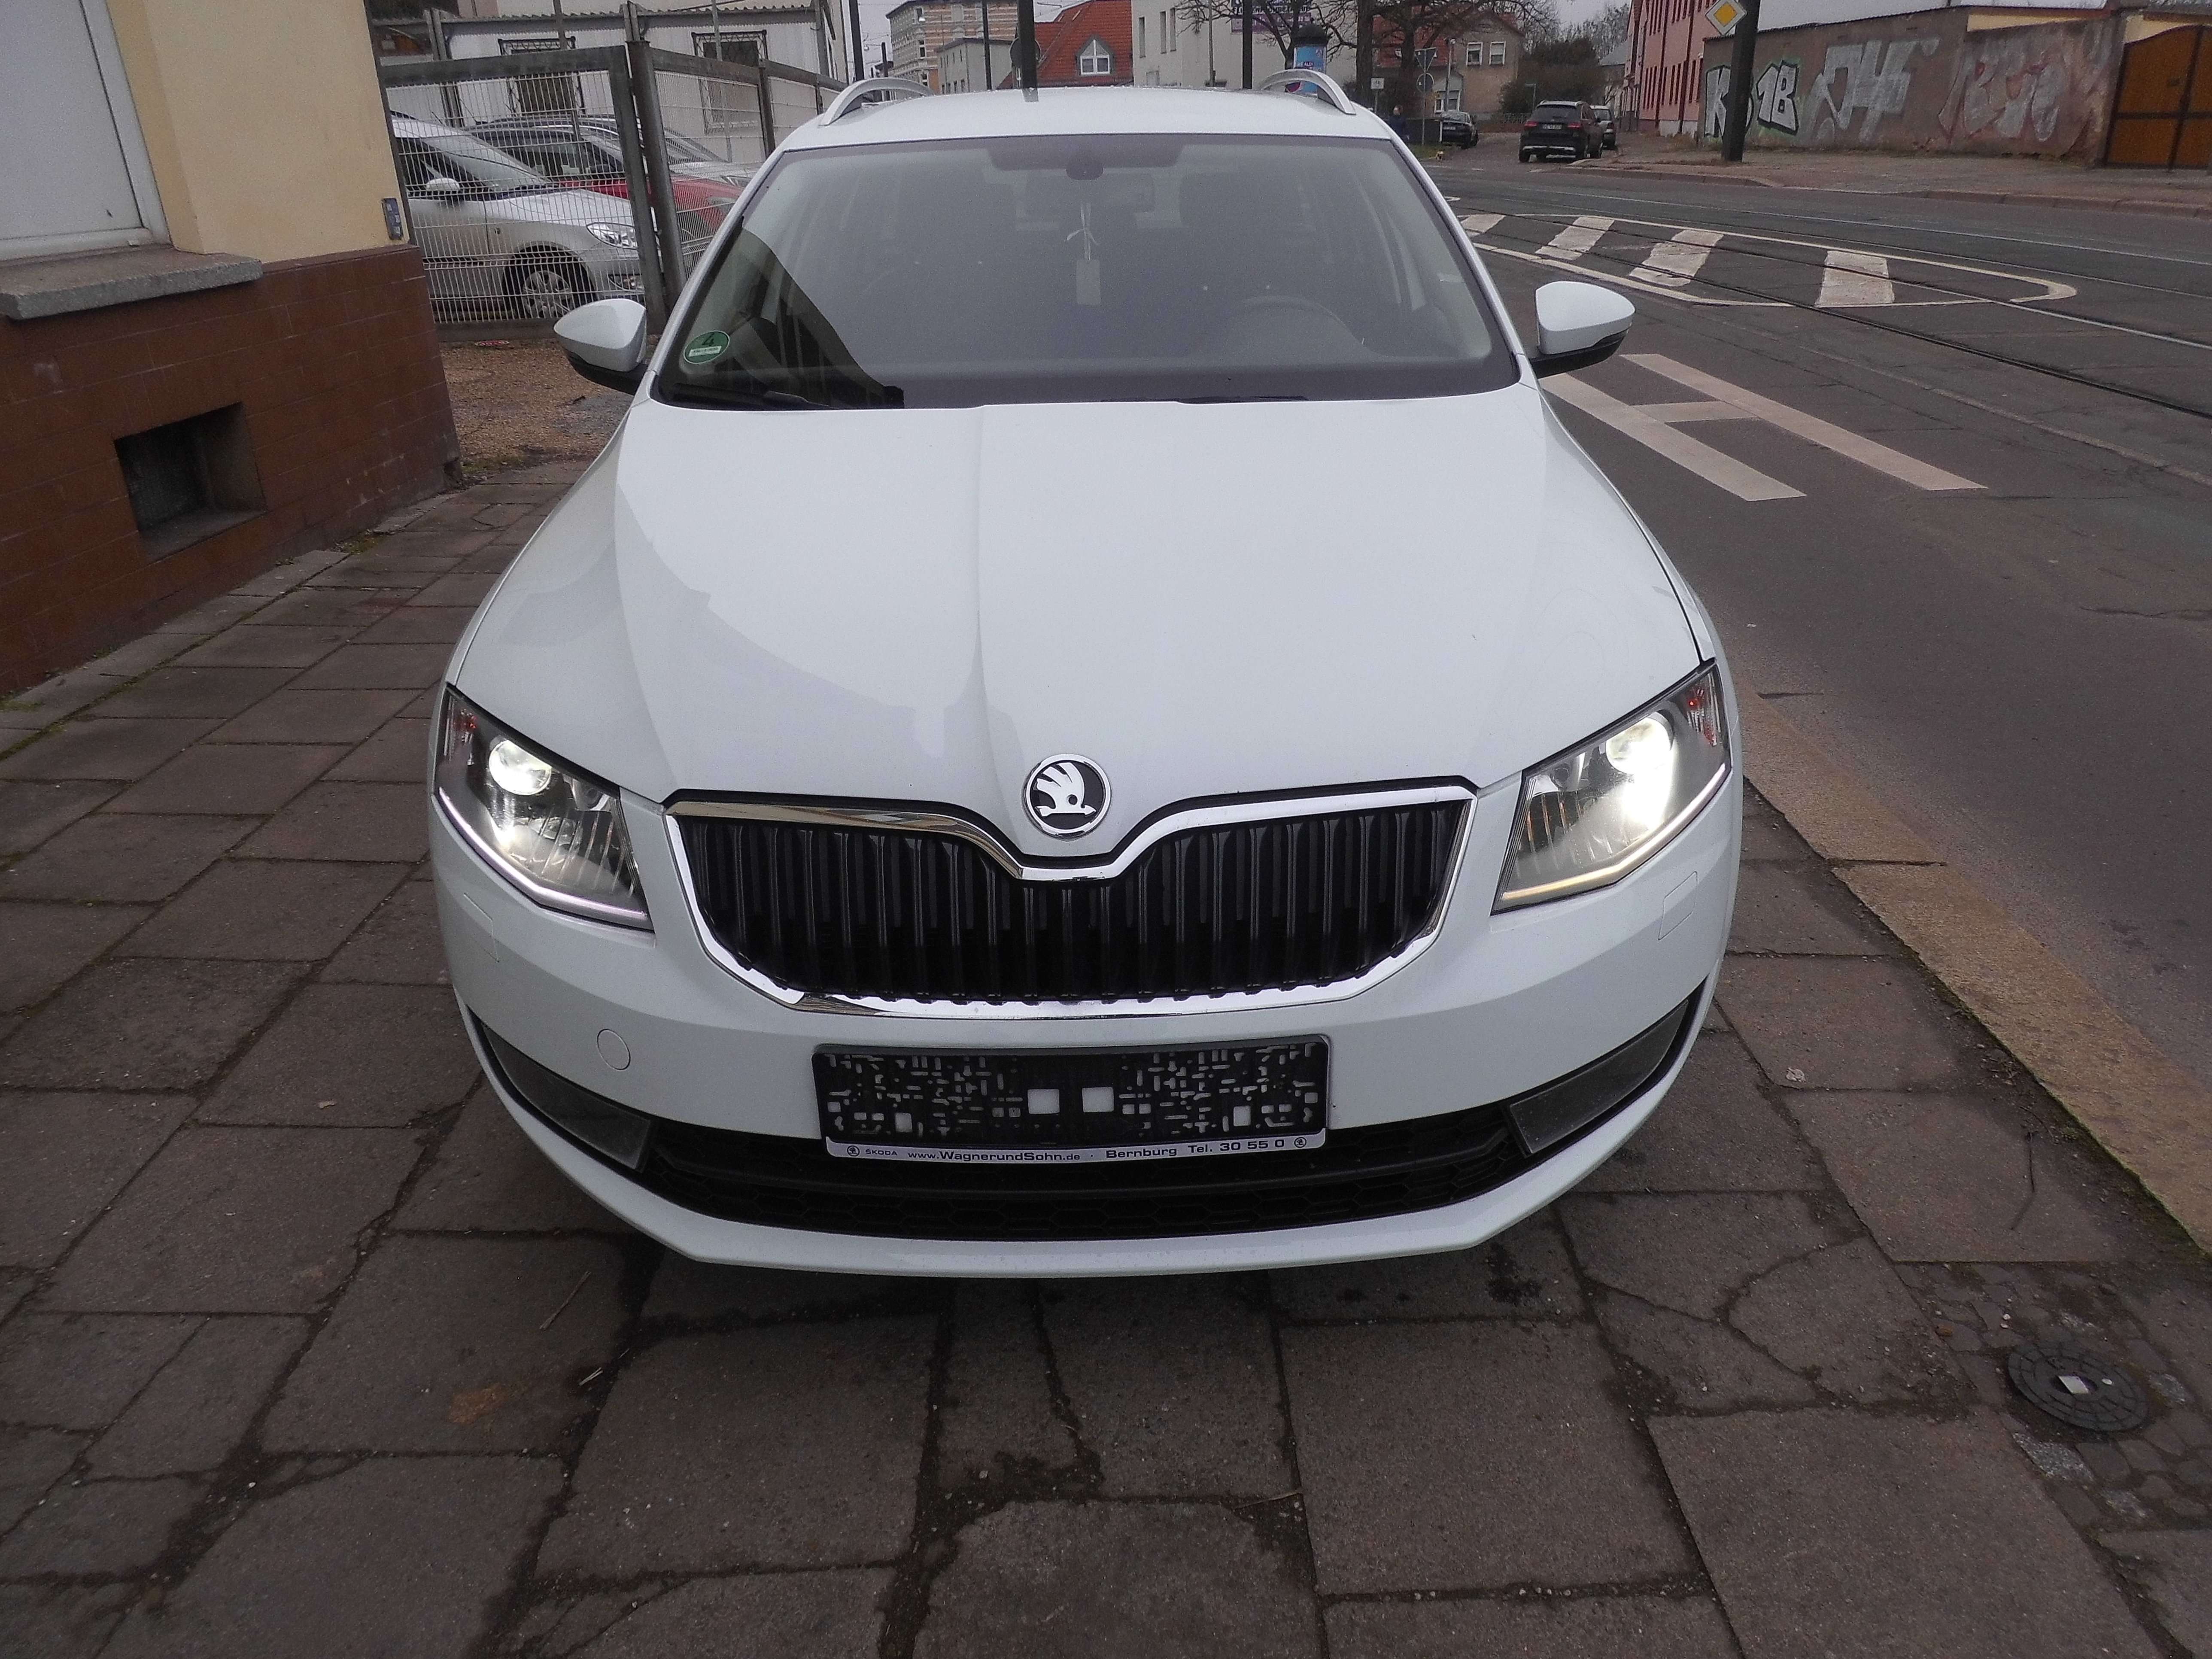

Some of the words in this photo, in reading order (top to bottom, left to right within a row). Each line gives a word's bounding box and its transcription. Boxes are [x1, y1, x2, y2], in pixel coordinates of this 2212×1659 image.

[702, 333, 715, 346] 4
[908, 1151, 1080, 1162] www.WagnerundSohn.de
[1106, 1148, 1177, 1158] Bernburg
[1188, 1144, 1213, 1153] Tel.
[1219, 1142, 1241, 1152] 30
[1247, 1140, 1269, 1149] 55
[1274, 1139, 1285, 1148] 0
